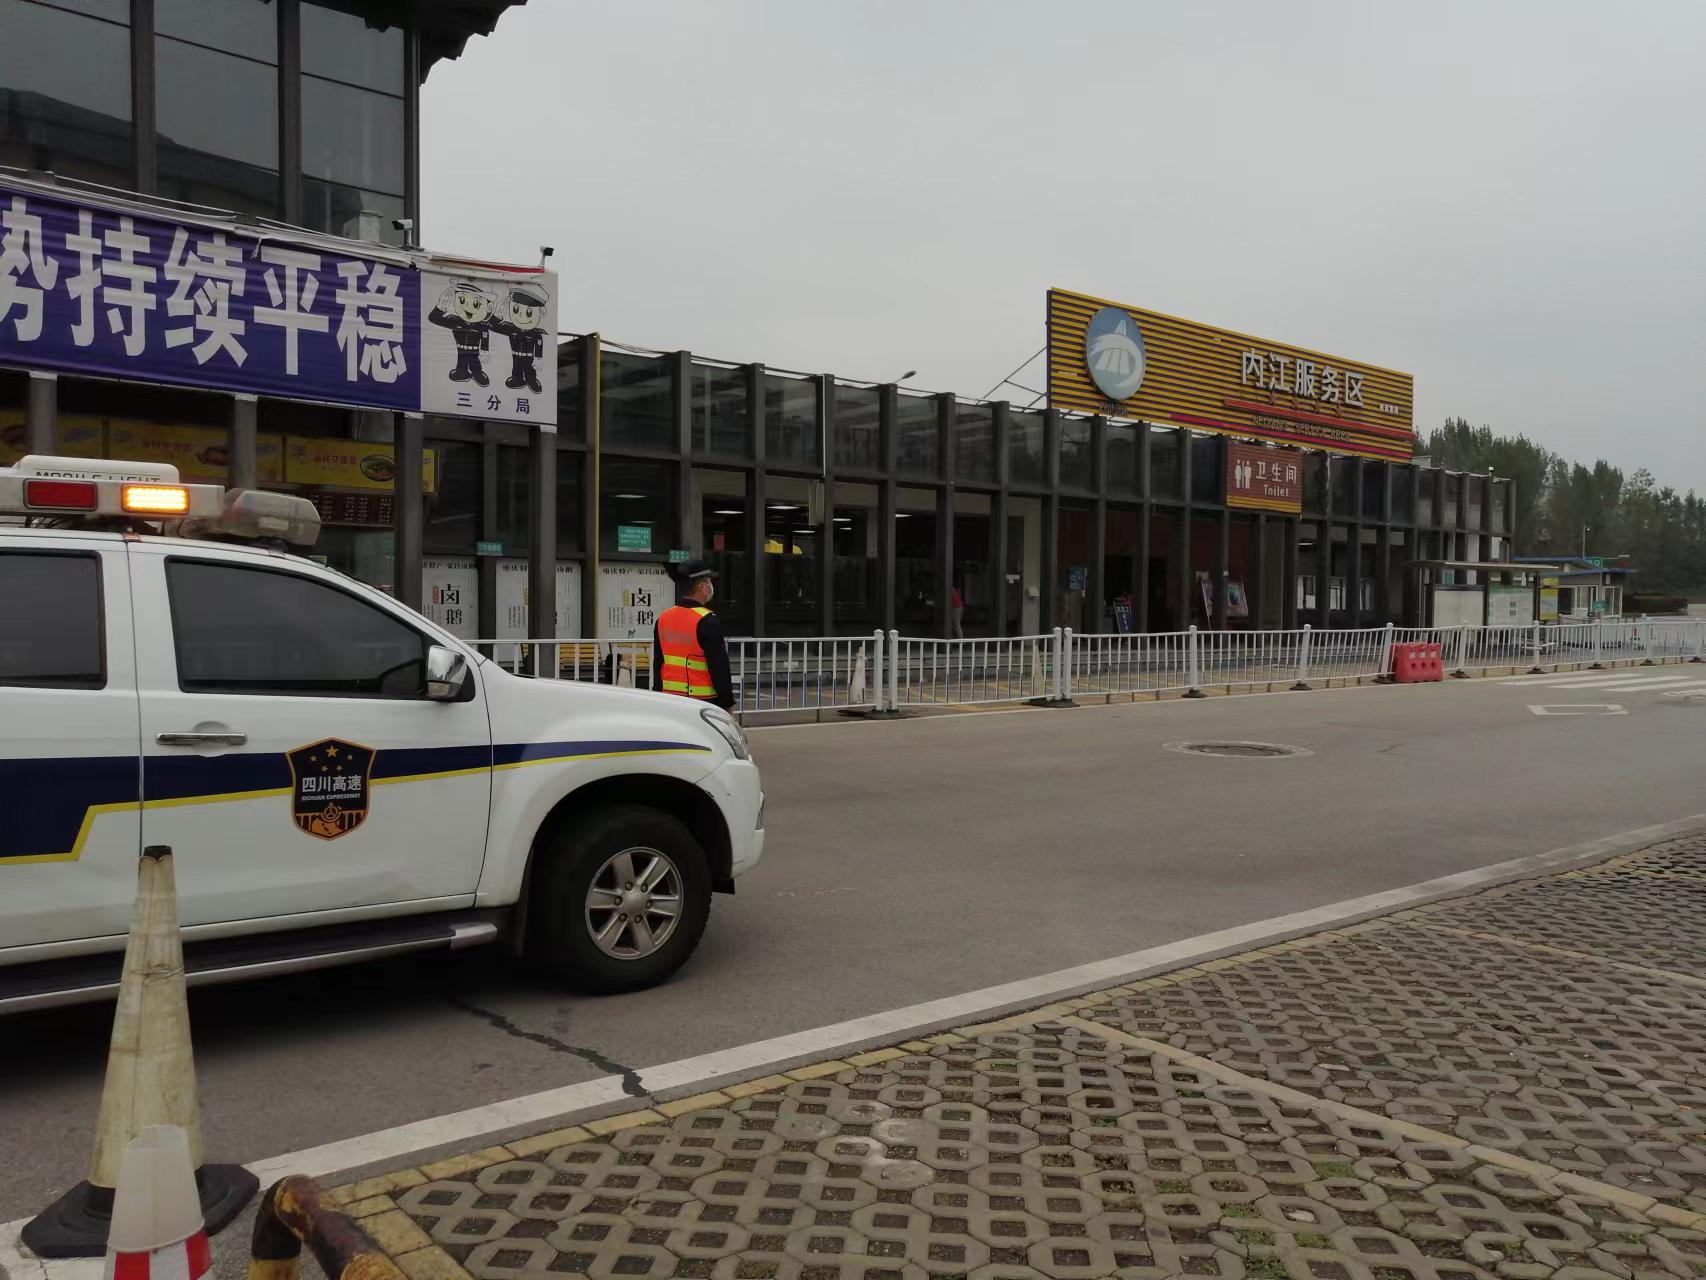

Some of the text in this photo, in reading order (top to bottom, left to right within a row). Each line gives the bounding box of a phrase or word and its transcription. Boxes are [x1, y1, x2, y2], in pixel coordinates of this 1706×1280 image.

[1242, 348, 1364, 407] 内江服务区
[456, 392, 531, 415] 三分局
[1255, 461, 1297, 485] 卫生间
[1263, 484, 1289, 497] Toilet
[440, 583, 462, 625] 卤鹅
[631, 587, 654, 626] 卤鹅
[301, 775, 362, 792] 四川高速
